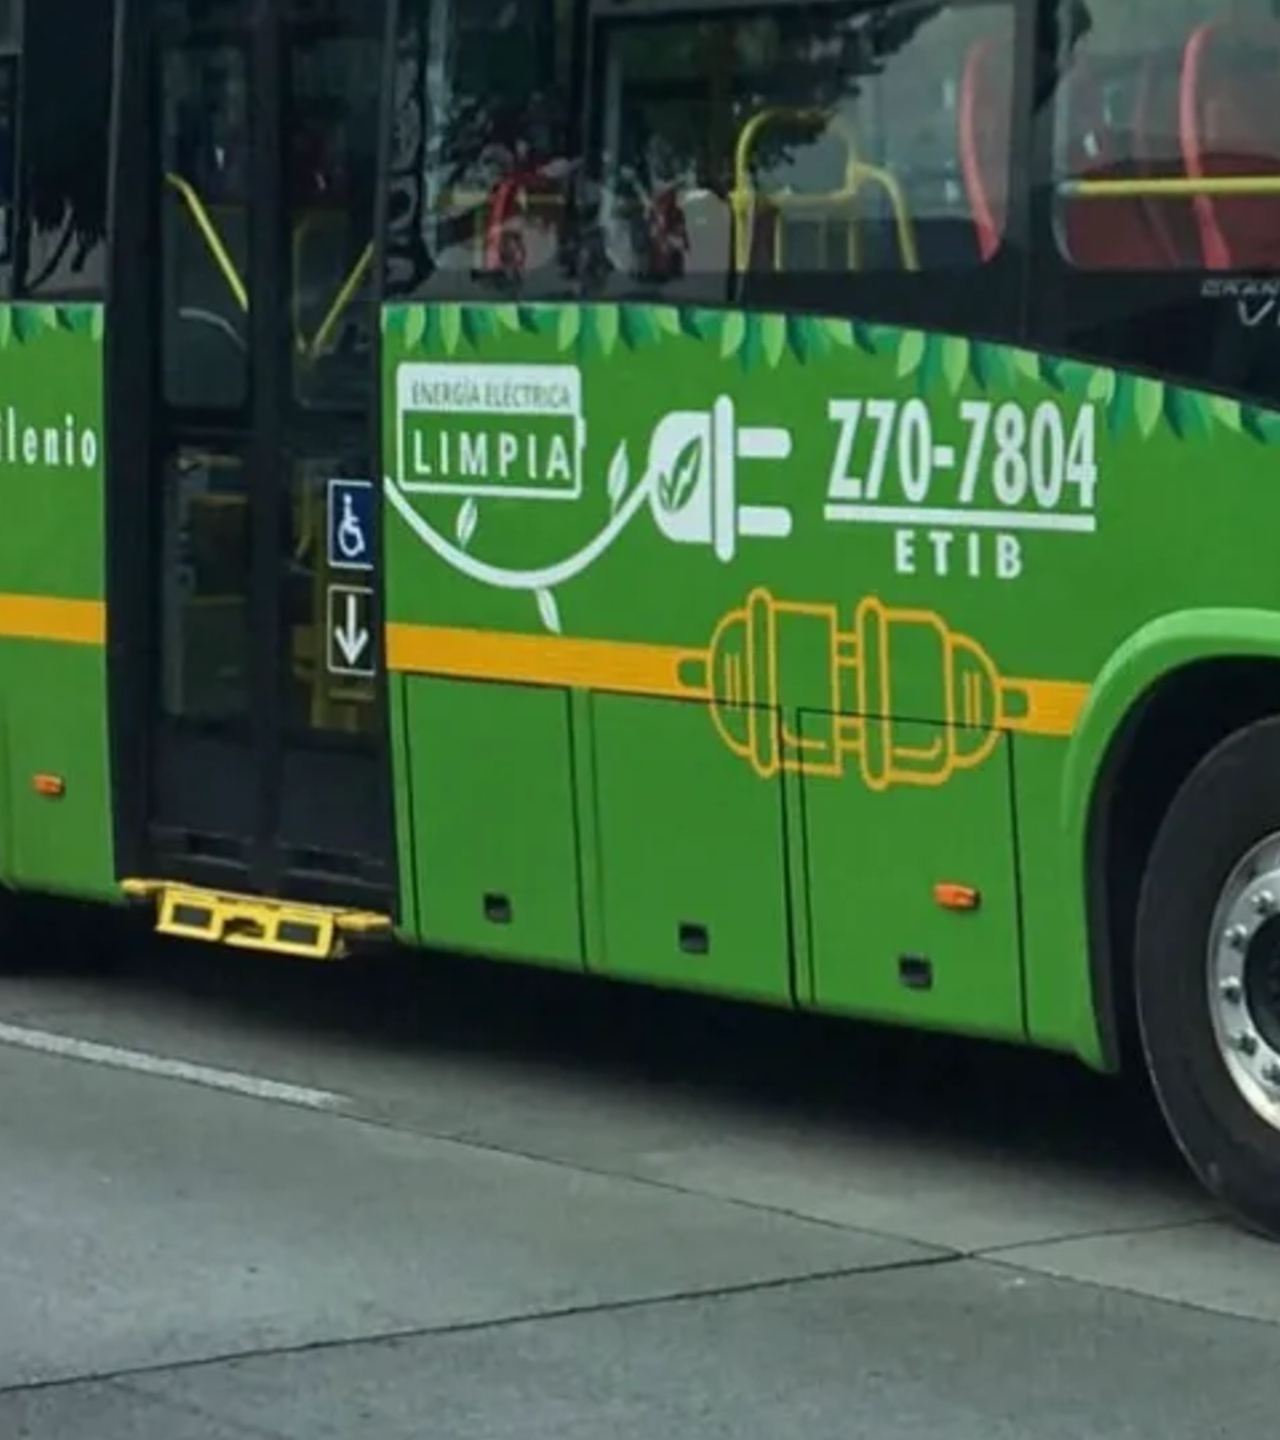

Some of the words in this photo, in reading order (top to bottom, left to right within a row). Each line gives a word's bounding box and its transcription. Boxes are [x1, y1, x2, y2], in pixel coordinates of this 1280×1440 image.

[414, 429, 570, 480] LIMPIA
[827, 398, 1097, 508] Z70-7804
[895, 529, 1022, 579] ETIB
